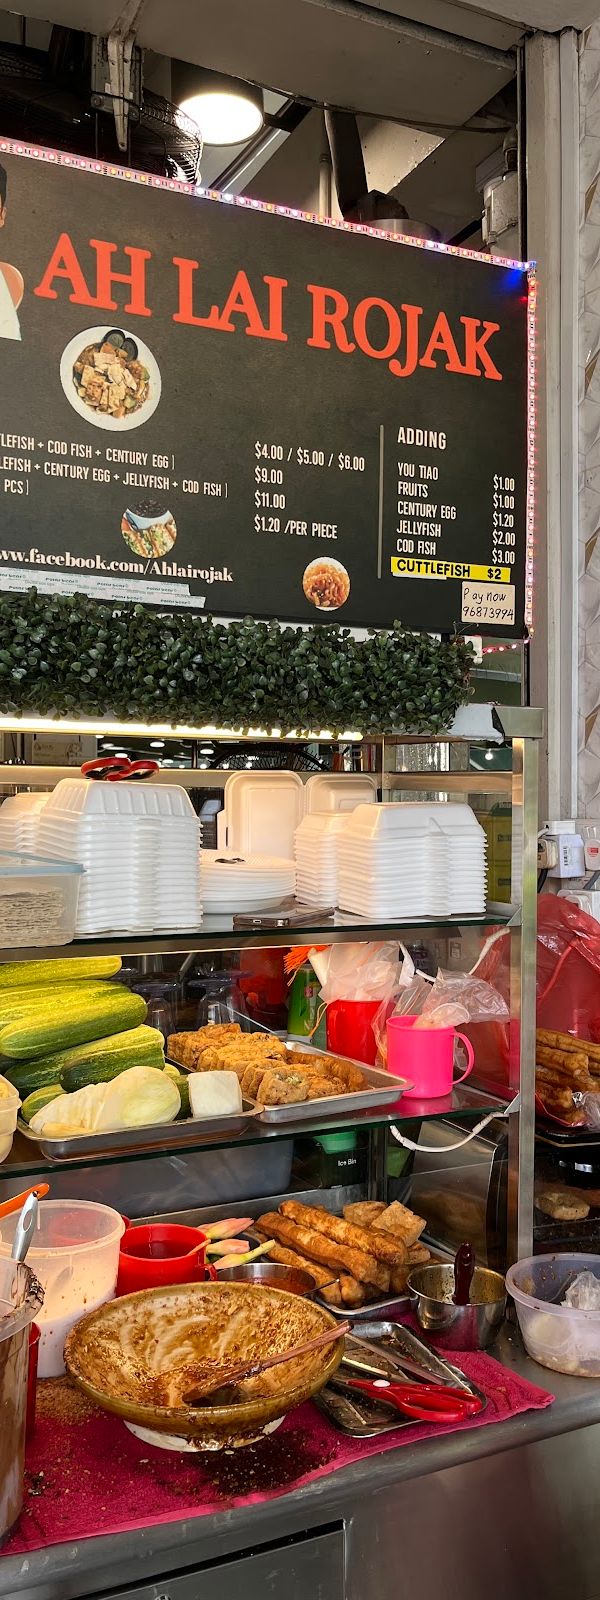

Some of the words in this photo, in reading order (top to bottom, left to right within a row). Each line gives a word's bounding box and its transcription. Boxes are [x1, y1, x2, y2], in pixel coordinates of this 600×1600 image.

[33, 232, 153, 317] AH
[172, 256, 289, 342] LAI
[306, 284, 503, 381] ROJAK
[397, 426, 447, 450] ADDING
[0, 432, 35, 451] LEFISH
[47, 439, 68, 455] COD
[70, 443, 92, 459] FISH
[106, 448, 148, 466] CENTURY
[152, 454, 169, 469] EGG
[254, 440, 283, 460] $4.00
[297, 447, 325, 466] $5.00
[338, 452, 365, 471] $6.00
[44, 461, 89, 480] CENTURY
[92, 468, 111, 483] EGG
[122, 472, 170, 490] JELLYFISH
[182, 479, 199, 494] COD
[203, 482, 222, 497] FISH
[254, 465, 283, 484] $9.00
[397, 462, 415, 478] YOU
[419, 464, 439, 481] TIAO
[4, 479, 24, 494] PCS
[397, 480, 429, 498] FRUITS
[493, 474, 515, 491] $1.00
[254, 489, 286, 509] $11.00
[493, 492, 515, 509] $1.00
[397, 500, 437, 518] CENTURY
[440, 505, 457, 520] EGG
[492, 511, 514, 528] $1.20
[254, 514, 281, 532] $1.20
[311, 522, 338, 539] PIECE
[396, 520, 442, 537] JELLYFISH
[396, 538, 414, 554] COD
[417, 540, 437, 556] FISH
[492, 529, 515, 546] $2.00
[492, 547, 515, 564] $3.00
[397, 559, 471, 578] CUTTLEFISH
[487, 568, 502, 580] $2
[462, 606, 514, 621] 96873994
